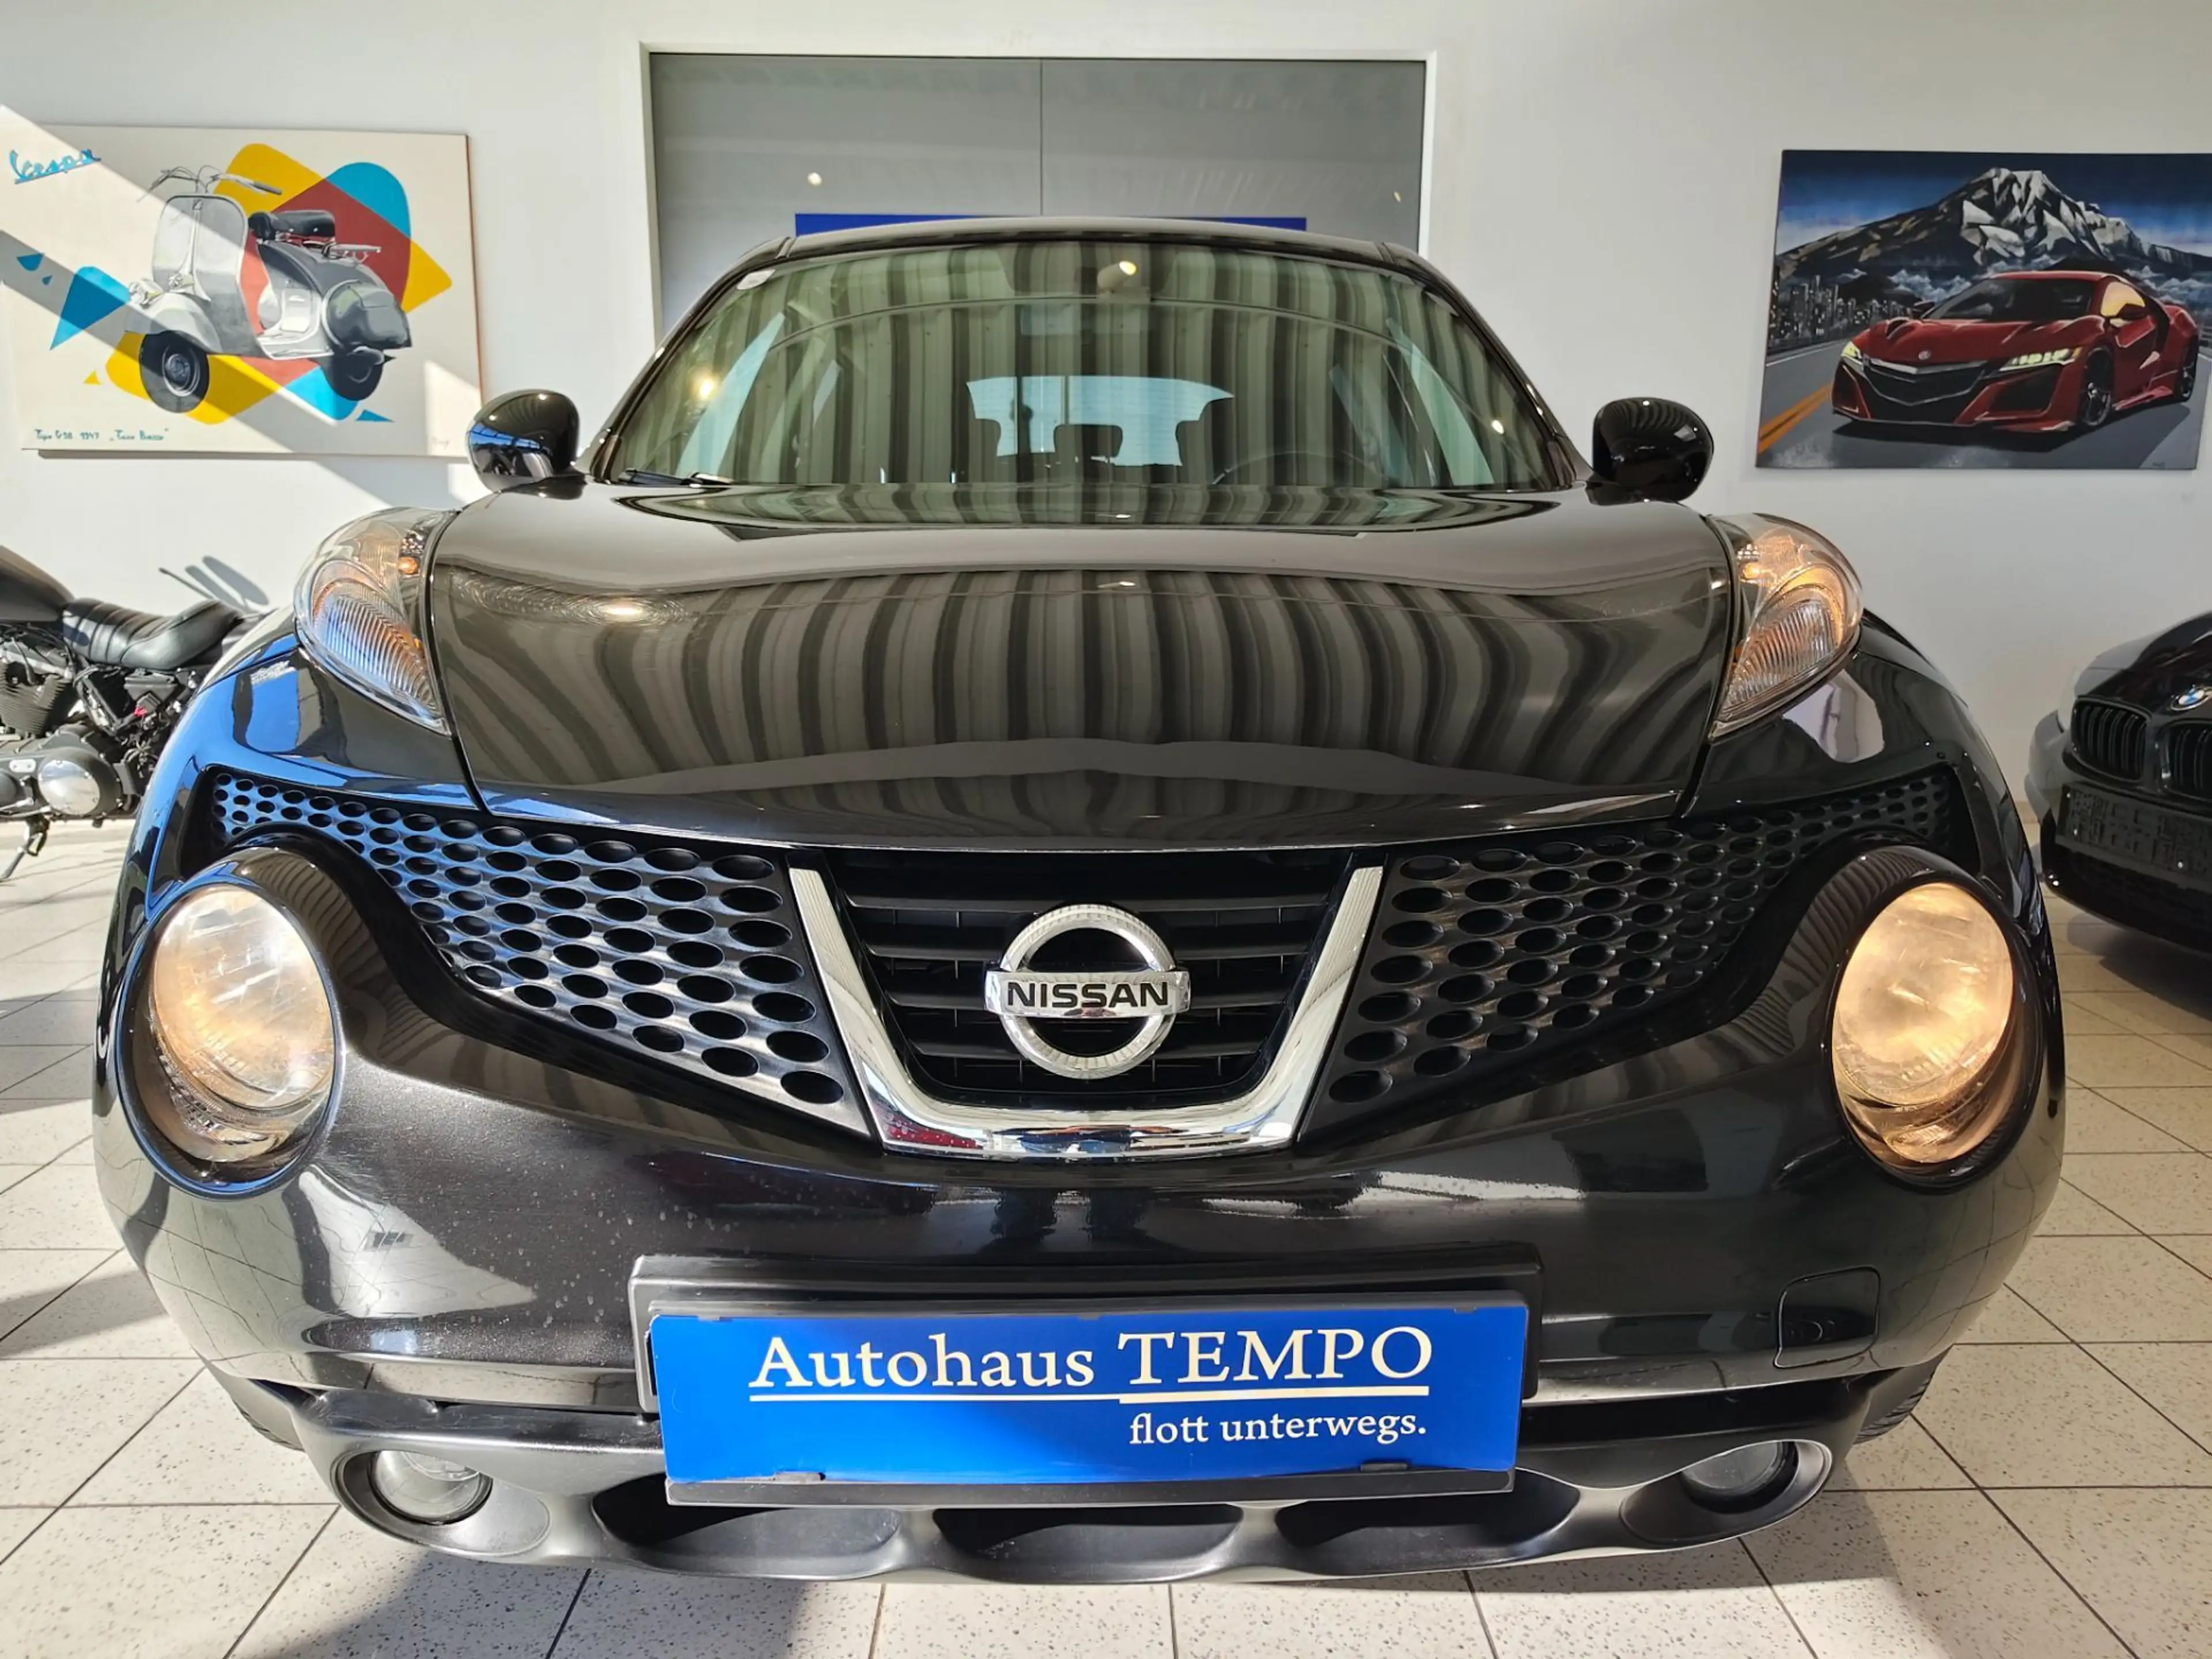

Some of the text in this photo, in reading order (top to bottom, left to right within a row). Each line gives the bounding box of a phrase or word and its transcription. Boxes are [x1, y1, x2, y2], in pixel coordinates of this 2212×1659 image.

[1007, 981, 1168, 1008] NISSAN
[748, 1326, 1433, 1388] Autohaus TEMPO
[1129, 1412, 1426, 1446] flott unterwegs.
